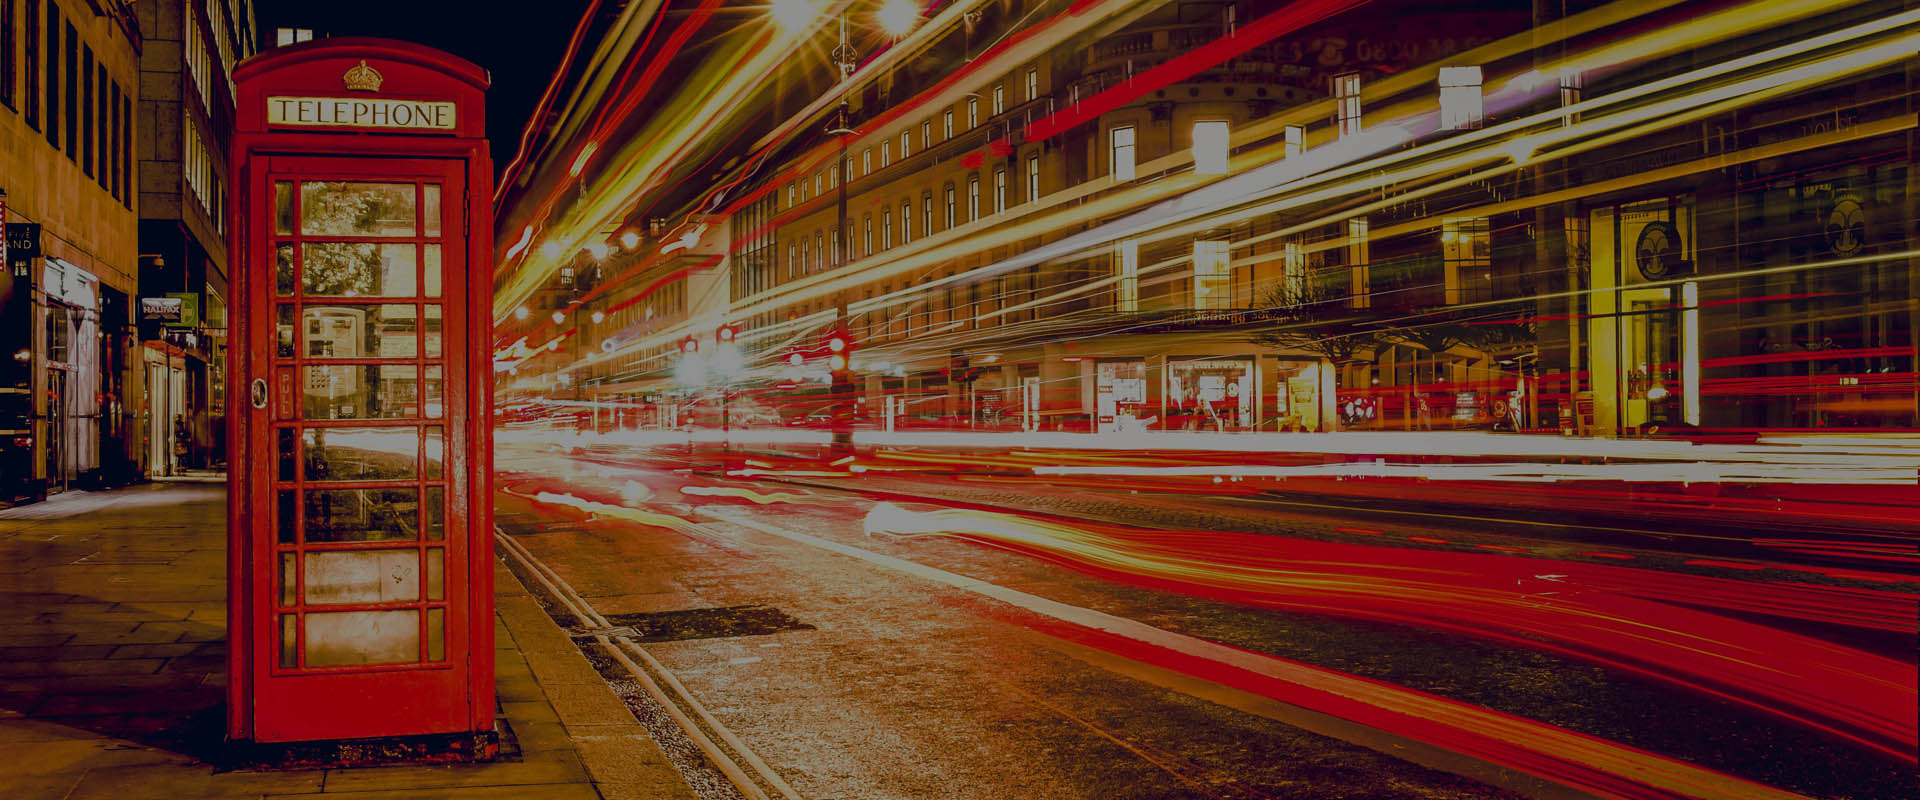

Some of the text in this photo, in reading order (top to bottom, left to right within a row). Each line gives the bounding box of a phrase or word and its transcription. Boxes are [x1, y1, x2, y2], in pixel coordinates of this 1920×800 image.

[275, 100, 449, 127] TELEPHONE
[143, 305, 180, 314] HALIFAX
[281, 374, 290, 415] PULL
